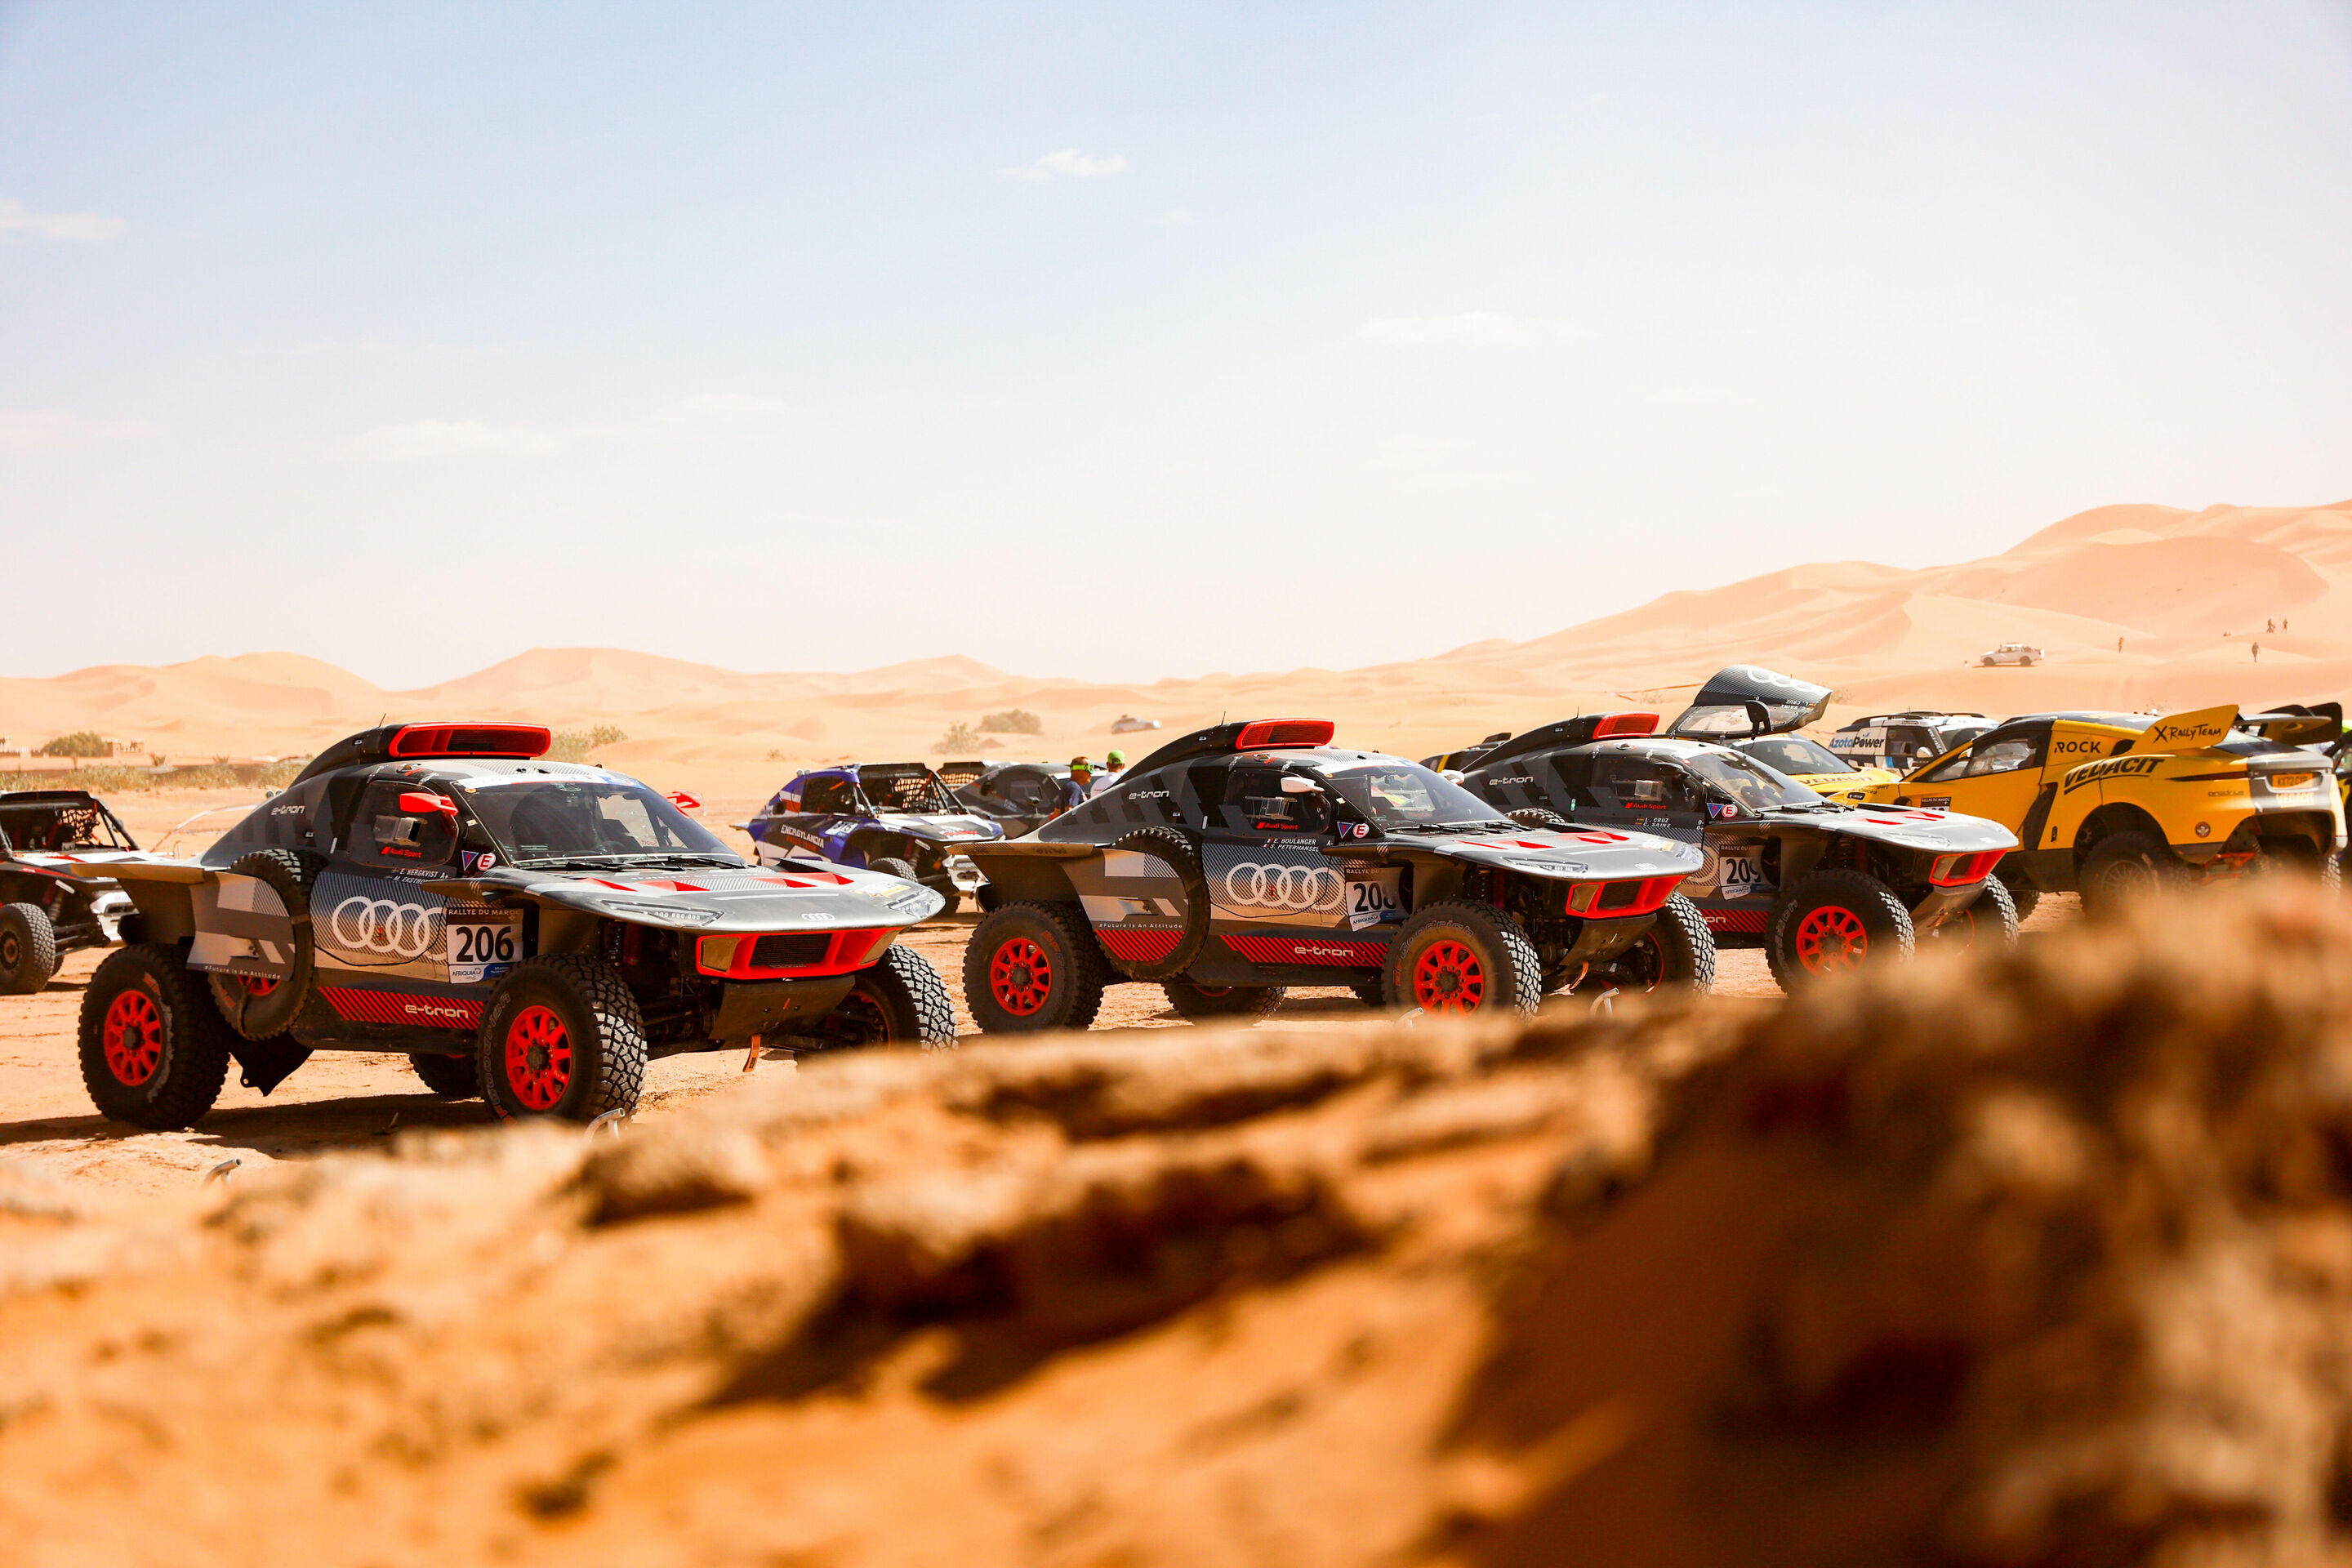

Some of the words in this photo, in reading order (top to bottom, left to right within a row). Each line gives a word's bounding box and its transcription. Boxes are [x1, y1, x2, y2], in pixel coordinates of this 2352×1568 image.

[2152, 725, 2168, 744] X
[1829, 737, 1884, 748] AzotoPower
[2054, 741, 2101, 754] ROCK
[2064, 757, 2165, 789] VEDACIT
[1489, 776, 1534, 786] e-tron
[1129, 790, 1170, 800] e-tron
[270, 805, 305, 815] e-tron
[781, 824, 824, 849] ENERGYLANDIA
[390, 847, 404, 855] Audi
[404, 849, 422, 858] Sport
[407, 869, 439, 878] BERGKVIST
[456, 926, 514, 962] 206
[1294, 947, 1354, 957] e-tron
[404, 1004, 469, 1019] e-tron
